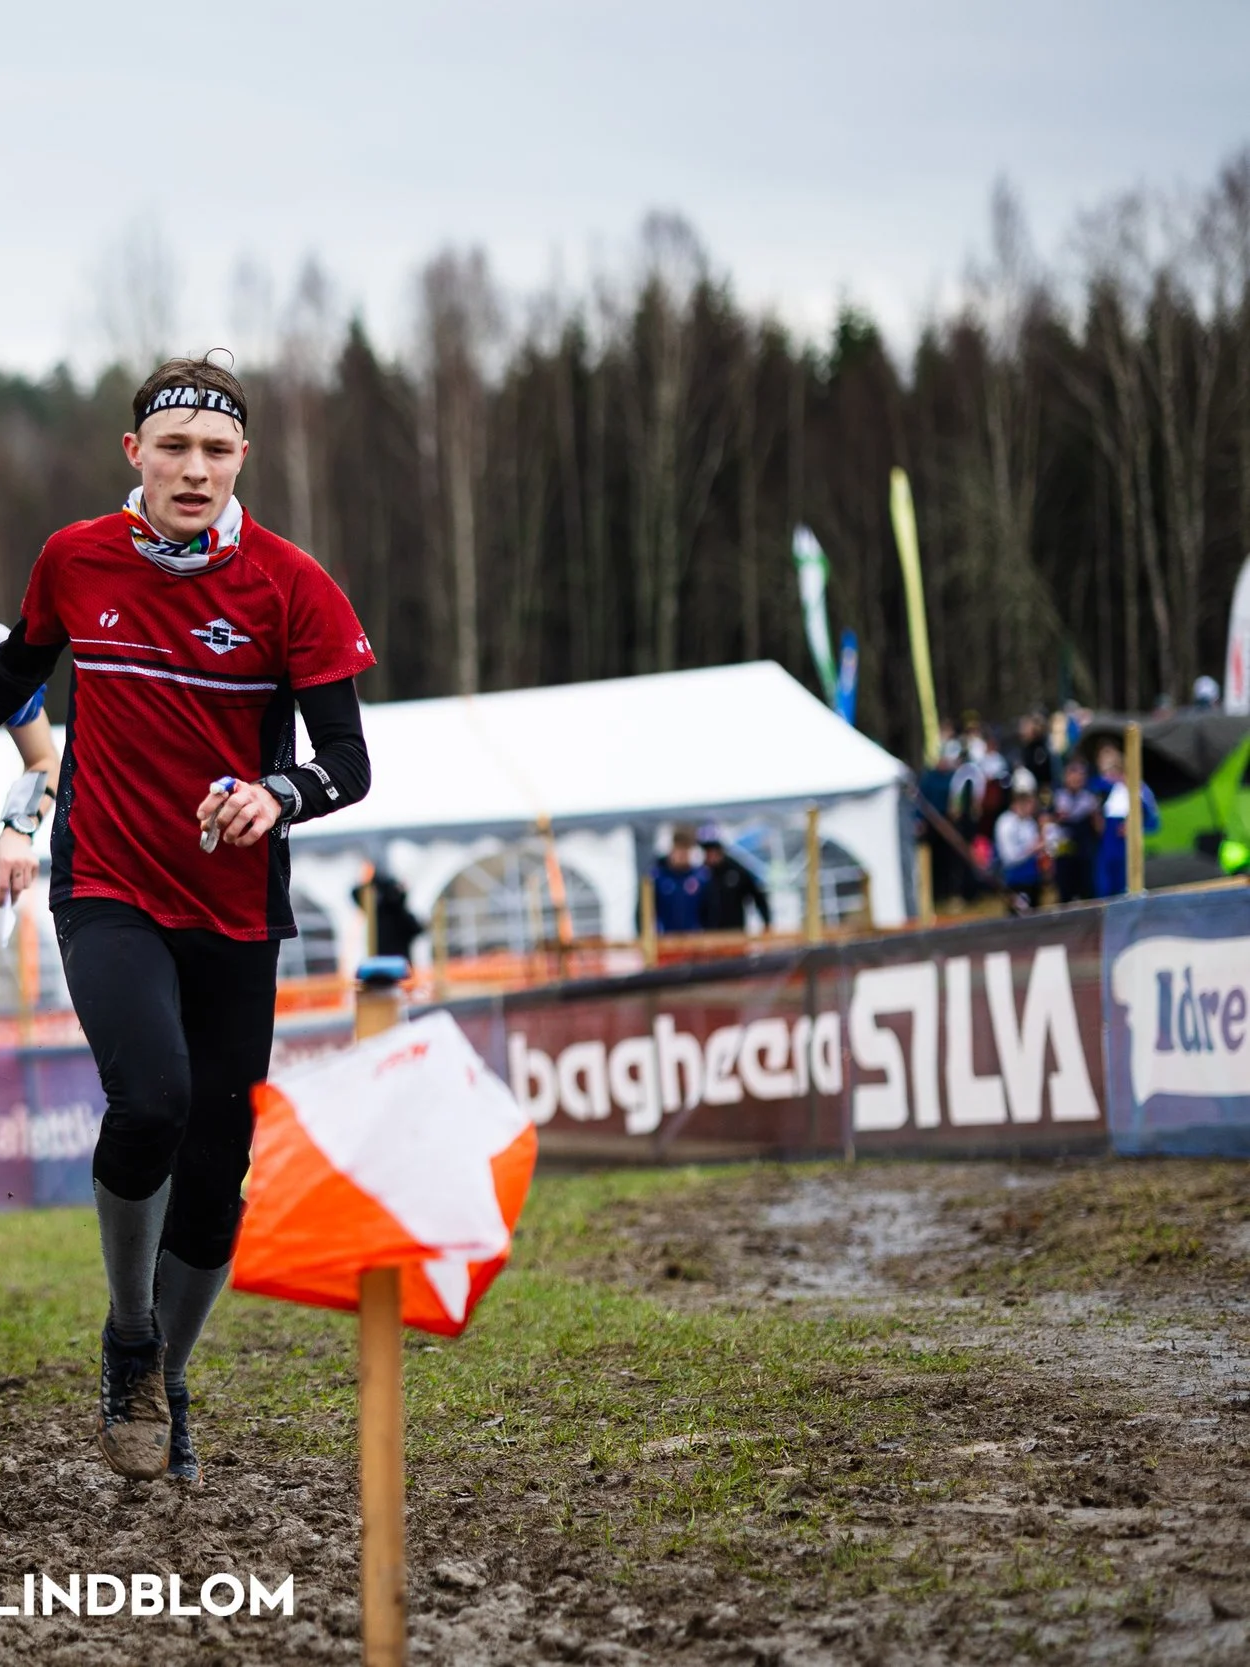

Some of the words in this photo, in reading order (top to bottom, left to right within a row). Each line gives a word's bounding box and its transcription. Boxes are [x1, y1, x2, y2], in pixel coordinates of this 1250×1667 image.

[849, 944, 1101, 1132] SILVA
[1154, 965, 1248, 1053] Idre
[507, 1012, 843, 1136] bagheera
